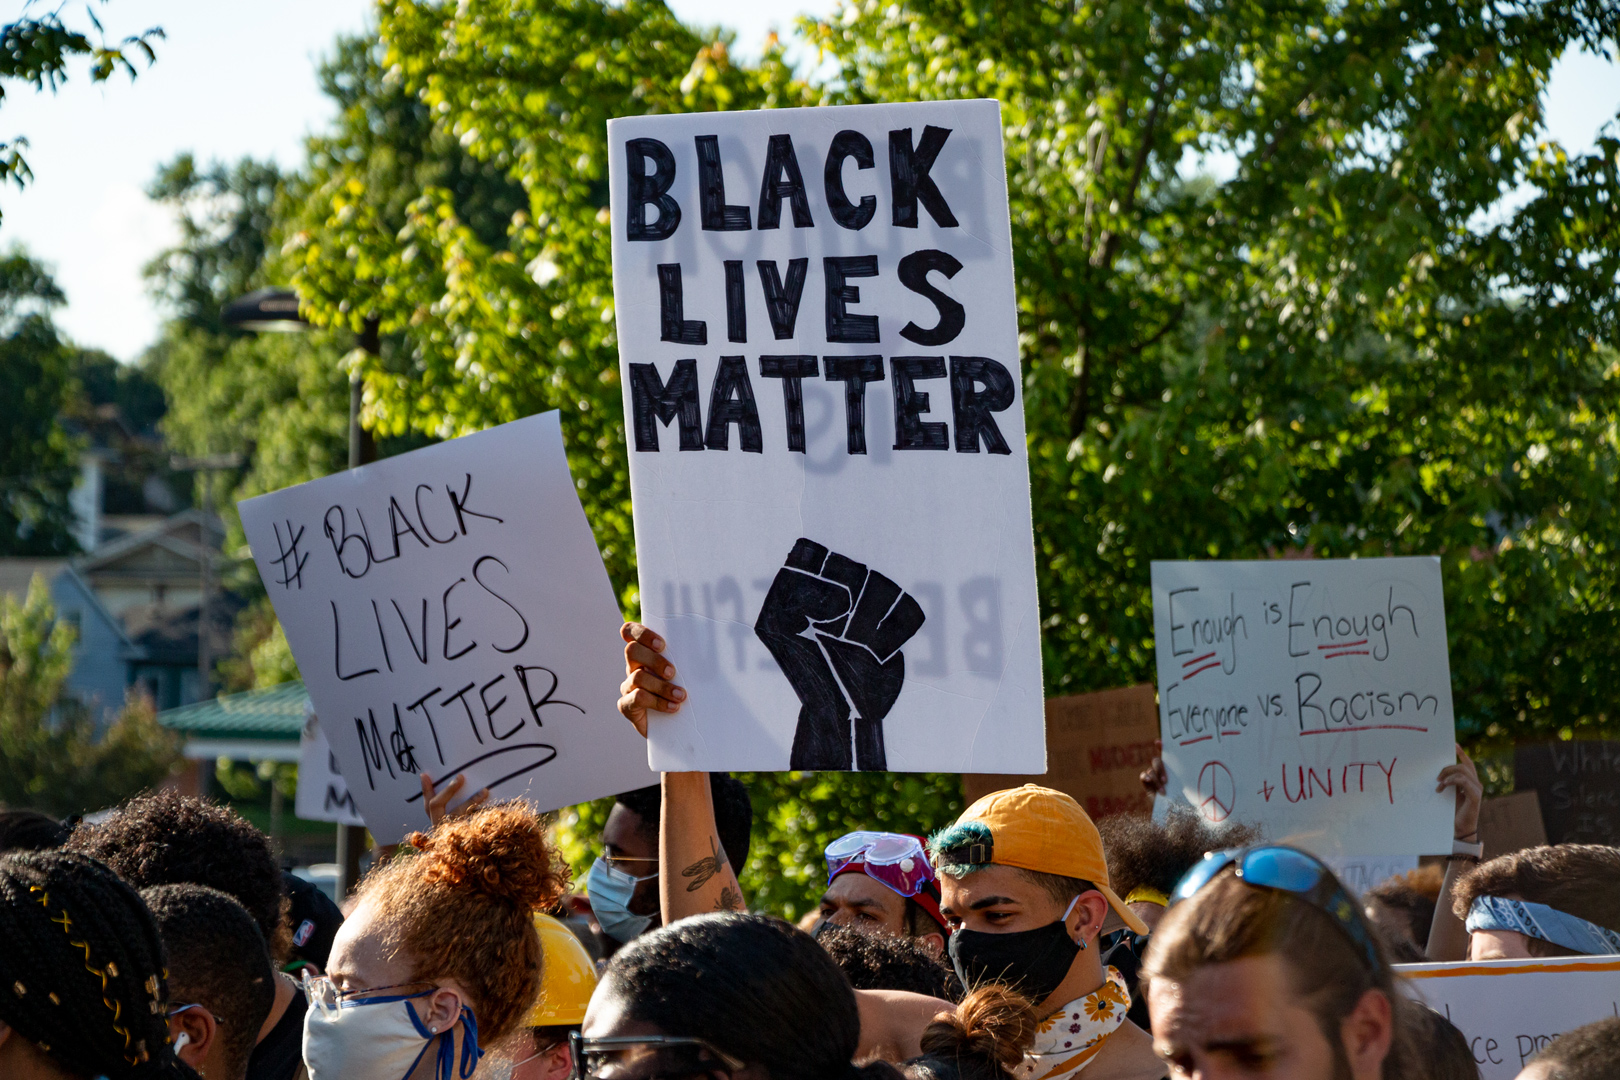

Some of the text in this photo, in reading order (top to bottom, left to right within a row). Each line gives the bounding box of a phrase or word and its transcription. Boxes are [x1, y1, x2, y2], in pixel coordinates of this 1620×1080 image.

[626, 125, 959, 241] BLACK
[657, 249, 966, 346] LIVES
[629, 355, 1015, 454] MATTER
[330, 556, 529, 681] LIVES
[1169, 582, 1419, 675] Enough is Enough
[1167, 683, 1248, 743] Everyone
[1257, 694, 1287, 718] vs.
[1295, 672, 1438, 732] Racism
[1282, 757, 1397, 805] UNITY
